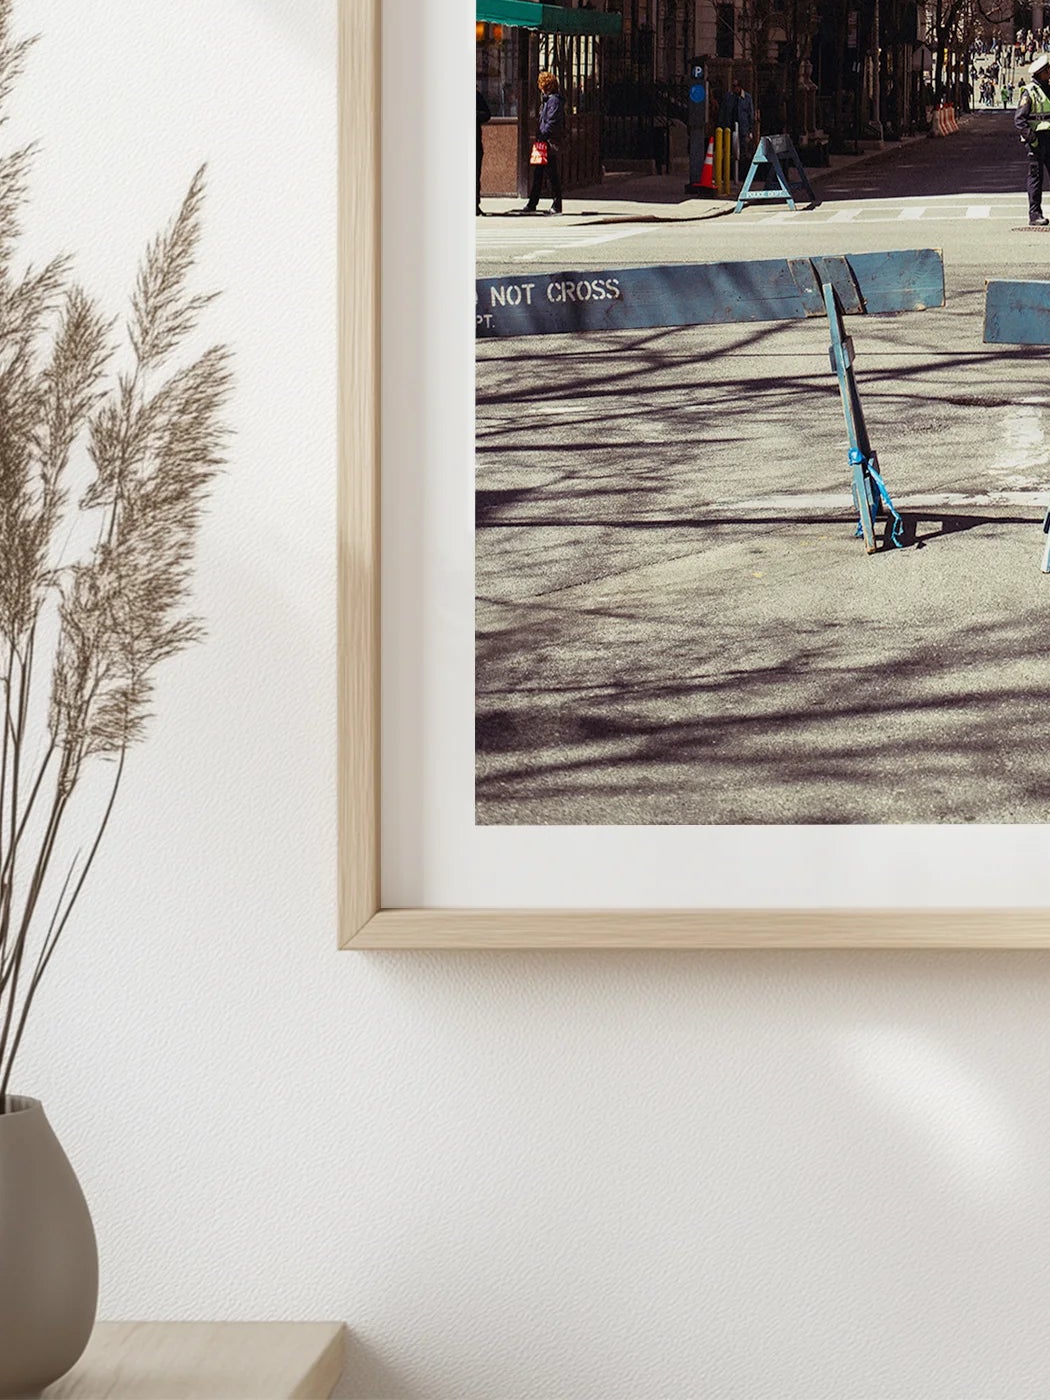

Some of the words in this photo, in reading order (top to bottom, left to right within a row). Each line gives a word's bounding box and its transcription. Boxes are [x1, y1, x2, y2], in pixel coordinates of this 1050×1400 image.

[694, 65, 703, 78] P
[490, 283, 535, 308] NOT
[546, 278, 621, 303] CROSS
